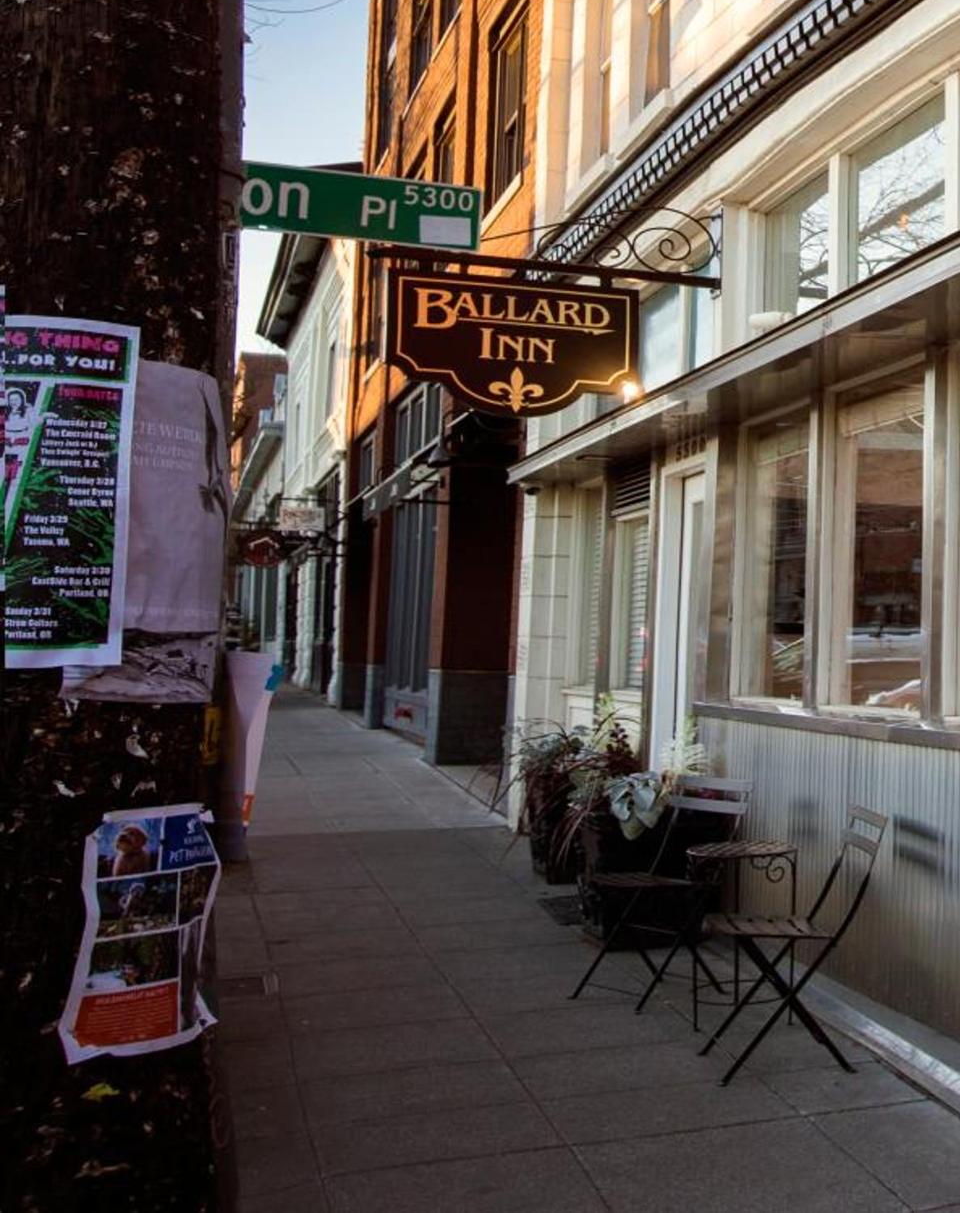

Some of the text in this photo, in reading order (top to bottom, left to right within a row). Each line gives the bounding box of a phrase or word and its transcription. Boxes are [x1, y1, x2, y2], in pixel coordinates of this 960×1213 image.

[360, 194, 398, 231] Pl
[403, 184, 476, 213] 5300
[412, 287, 612, 331] BALLARD
[38, 328, 120, 354] THING
[477, 327, 556, 365] INN
[65, 354, 116, 372] YOU!
